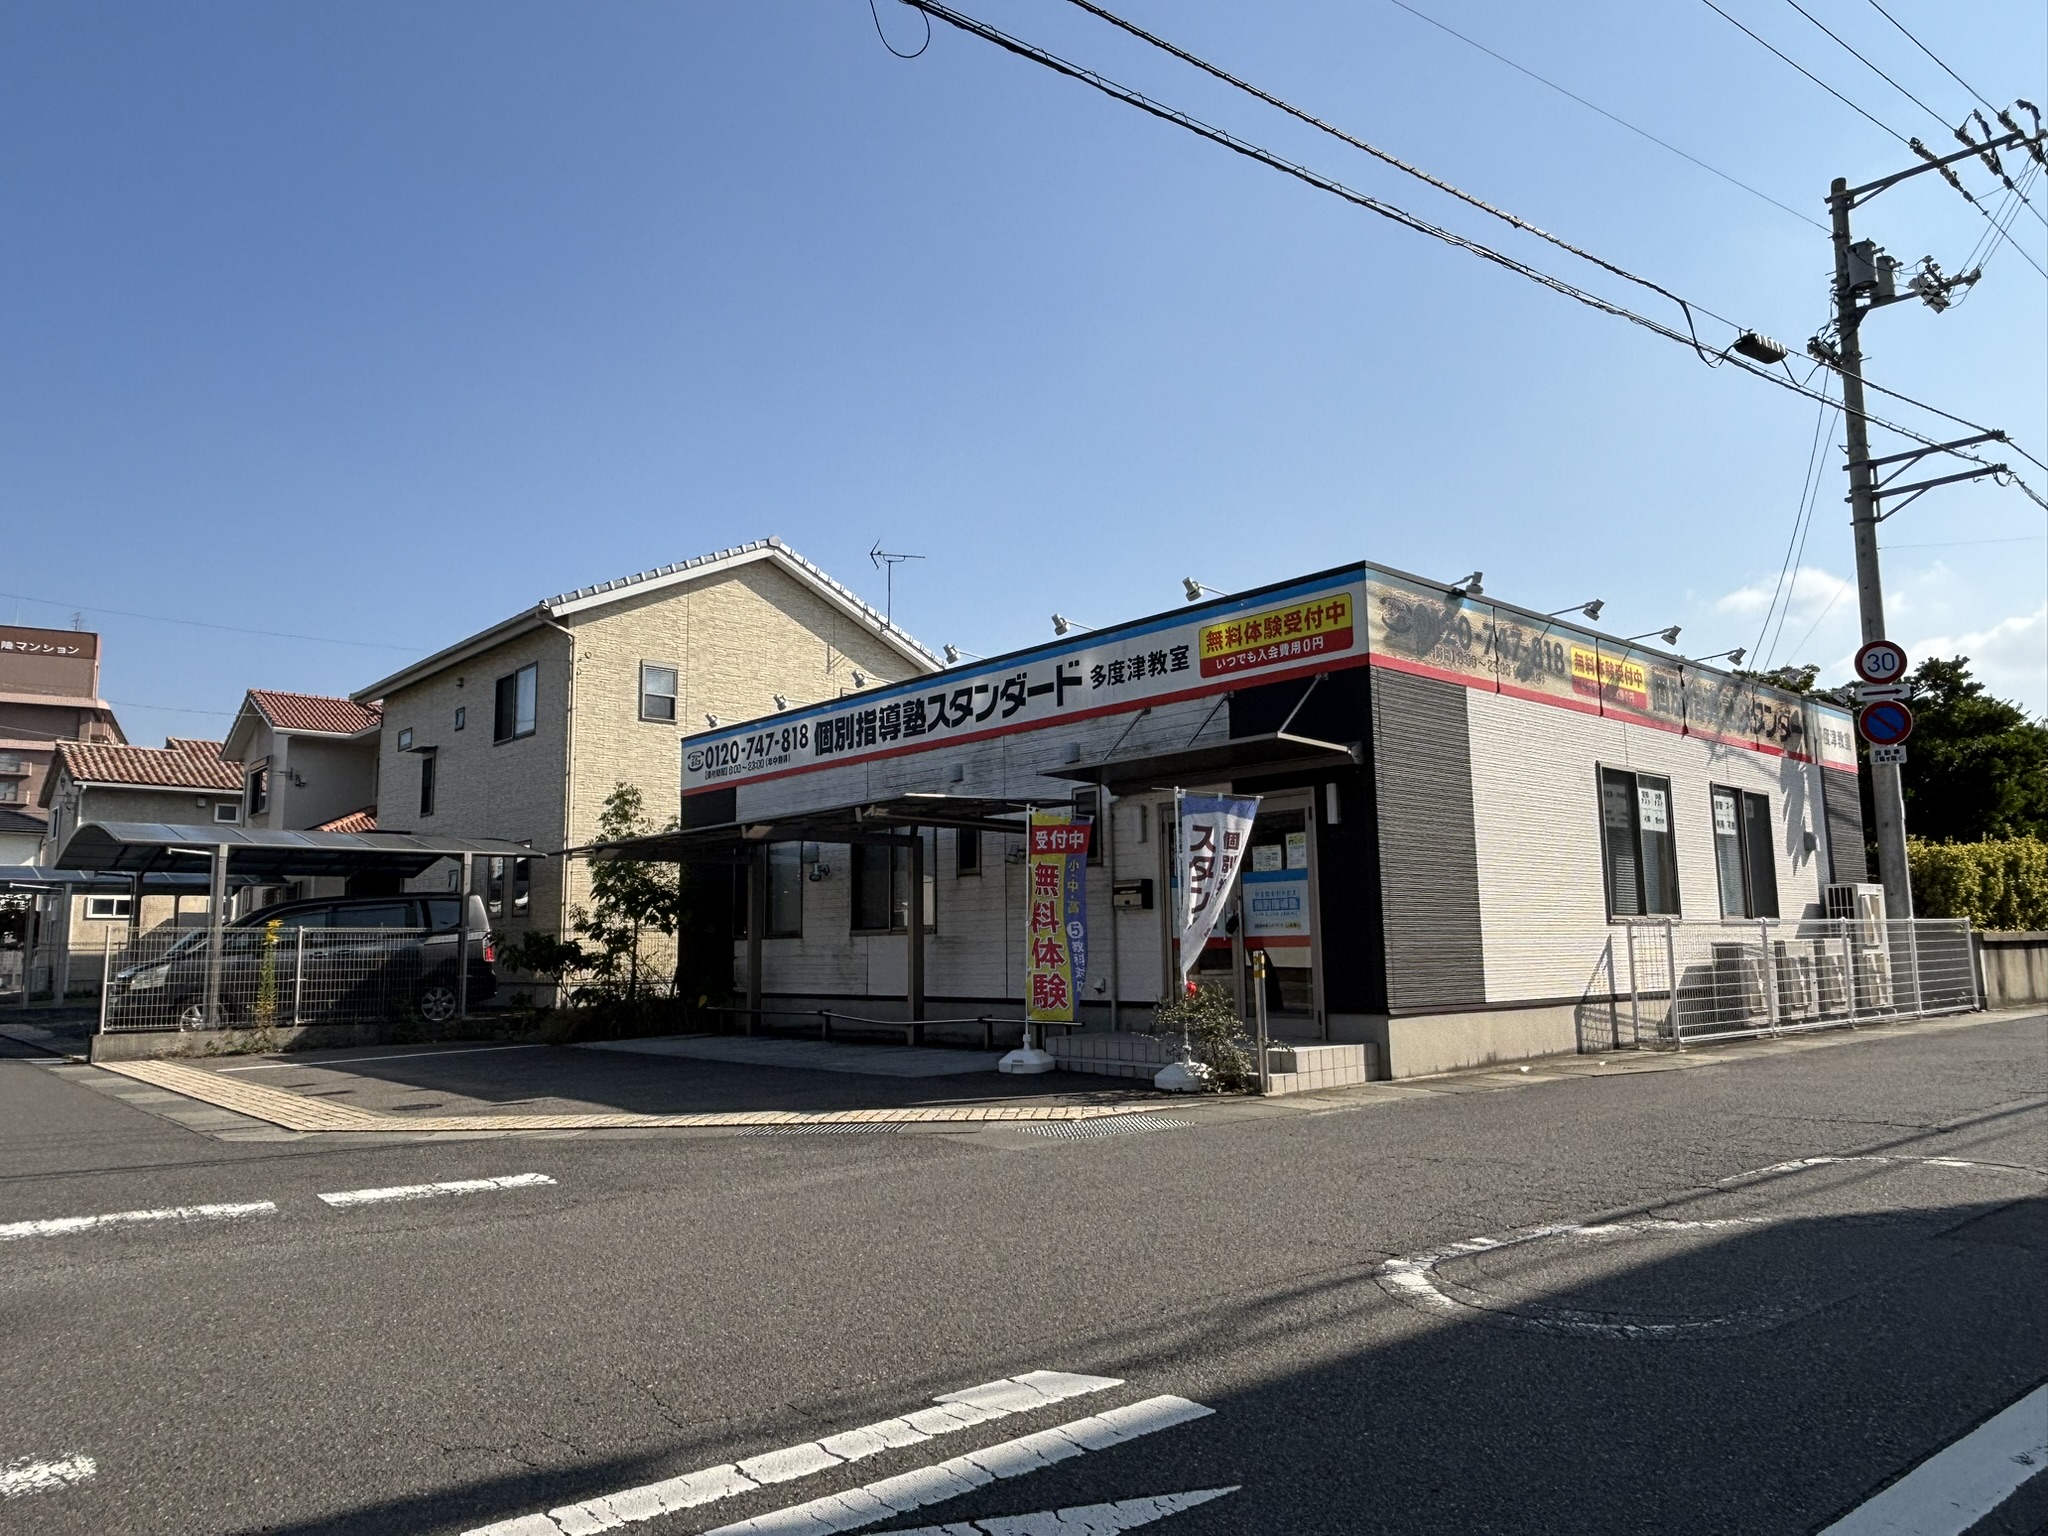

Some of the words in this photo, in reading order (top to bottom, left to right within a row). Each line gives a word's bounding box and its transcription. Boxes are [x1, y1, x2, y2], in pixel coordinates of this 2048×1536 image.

[1206, 601, 1346, 653] 無料体験受付中
[1867, 652, 1896, 673] 30
[704, 722, 809, 771] 0120-747-818
[1090, 645, 1190, 690] 多度津教室
[1035, 830, 1085, 850] 受付中
[1189, 824, 1217, 930] スタン
[1031, 861, 1068, 1010] 無料体験
